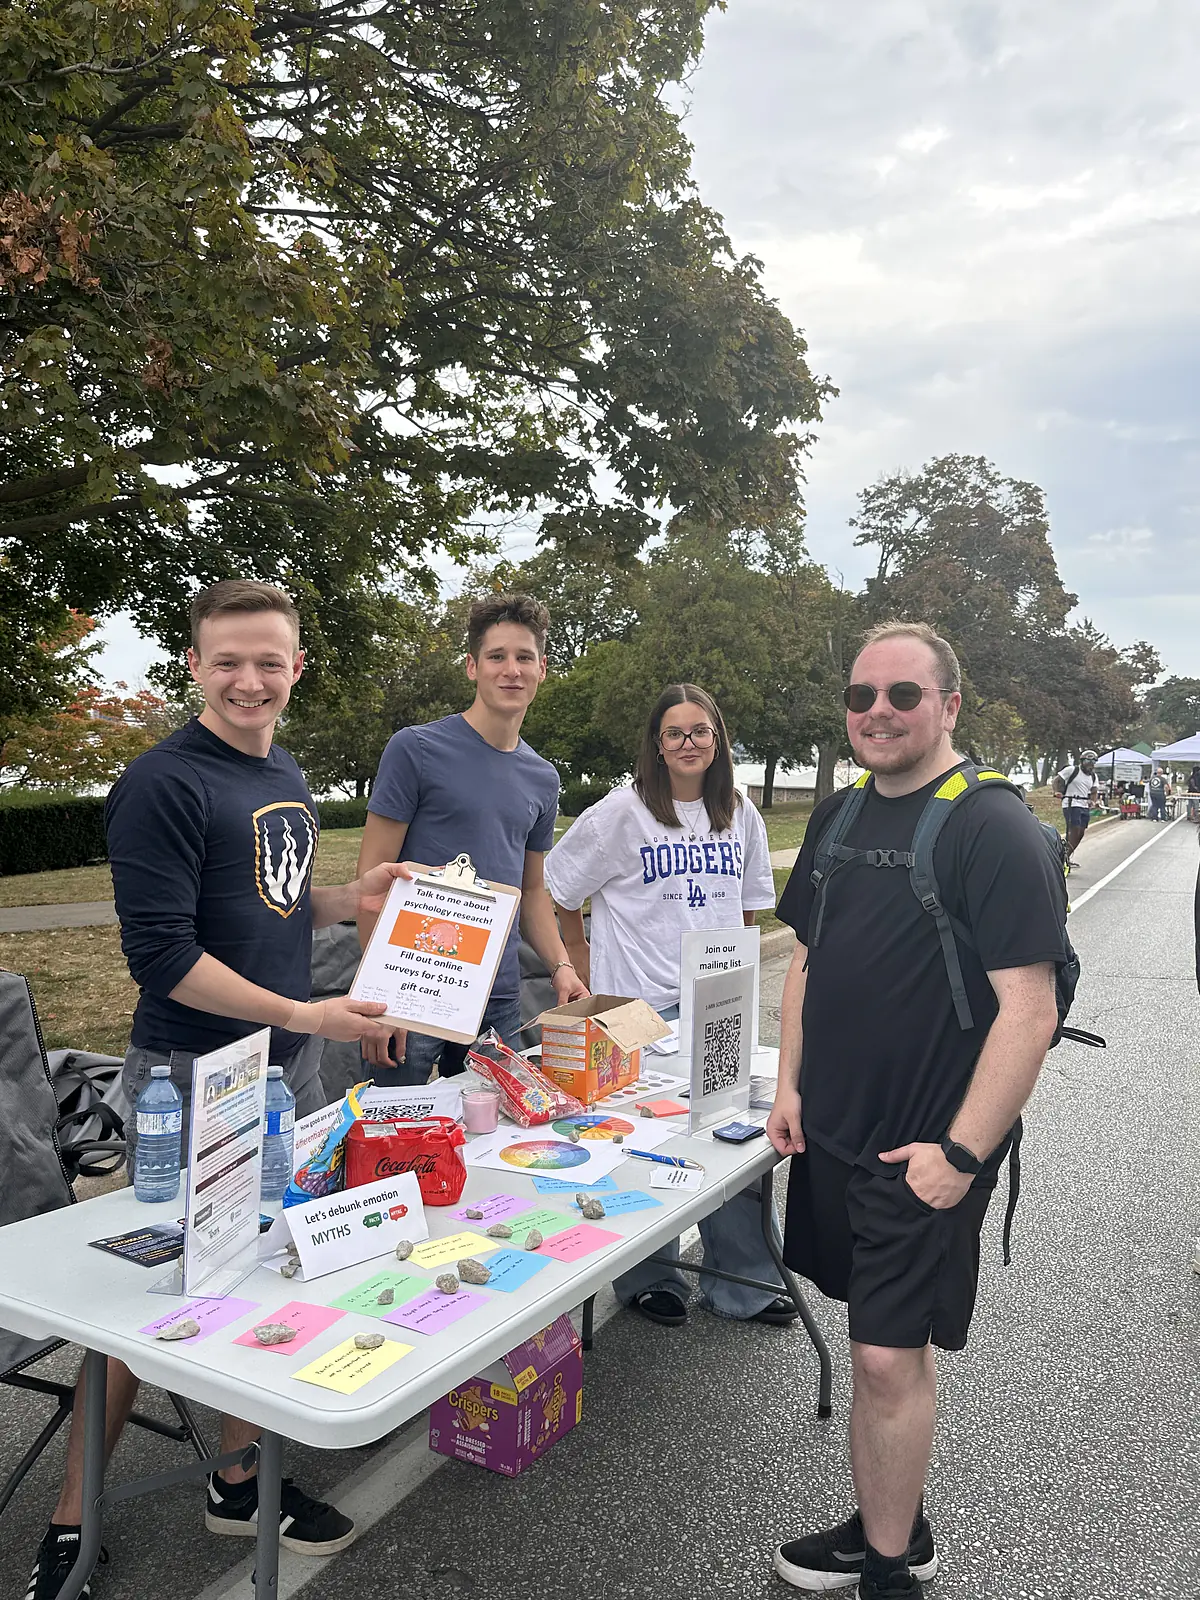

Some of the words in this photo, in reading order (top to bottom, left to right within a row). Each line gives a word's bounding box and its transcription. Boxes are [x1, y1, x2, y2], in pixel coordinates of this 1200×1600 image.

[640, 842, 742, 884] DODGERS
[416, 888, 434, 900] Talk
[436, 894, 446, 902] to
[446, 897, 462, 906] me
[463, 899, 490, 912] about
[687, 878, 706, 908] LA
[404, 900, 452, 917] psychology
[452, 911, 493, 926] research!
[704, 944, 720, 954] Join
[400, 950, 414, 961] Fill
[416, 954, 432, 965] out
[434, 958, 463, 972] online
[700, 960, 728, 970] mailing
[730, 960, 742, 968] list
[384, 962, 419, 978] surveys
[422, 970, 436, 980] for
[436, 974, 470, 989] $10-15
[400, 981, 418, 992] gift
[418, 986, 442, 998] card.
[310, 1116, 320, 1128] good
[375, 1153, 442, 1176] Coca-Cola
[304, 1208, 327, 1224] Let's
[328, 1199, 362, 1218] debunk
[362, 1190, 398, 1207] emotion
[311, 1224, 351, 1246] MYTHS
[492, 1388, 500, 1397] 18
[552, 1372, 562, 1433] Crispers
[448, 1390, 499, 1421] Crispers
